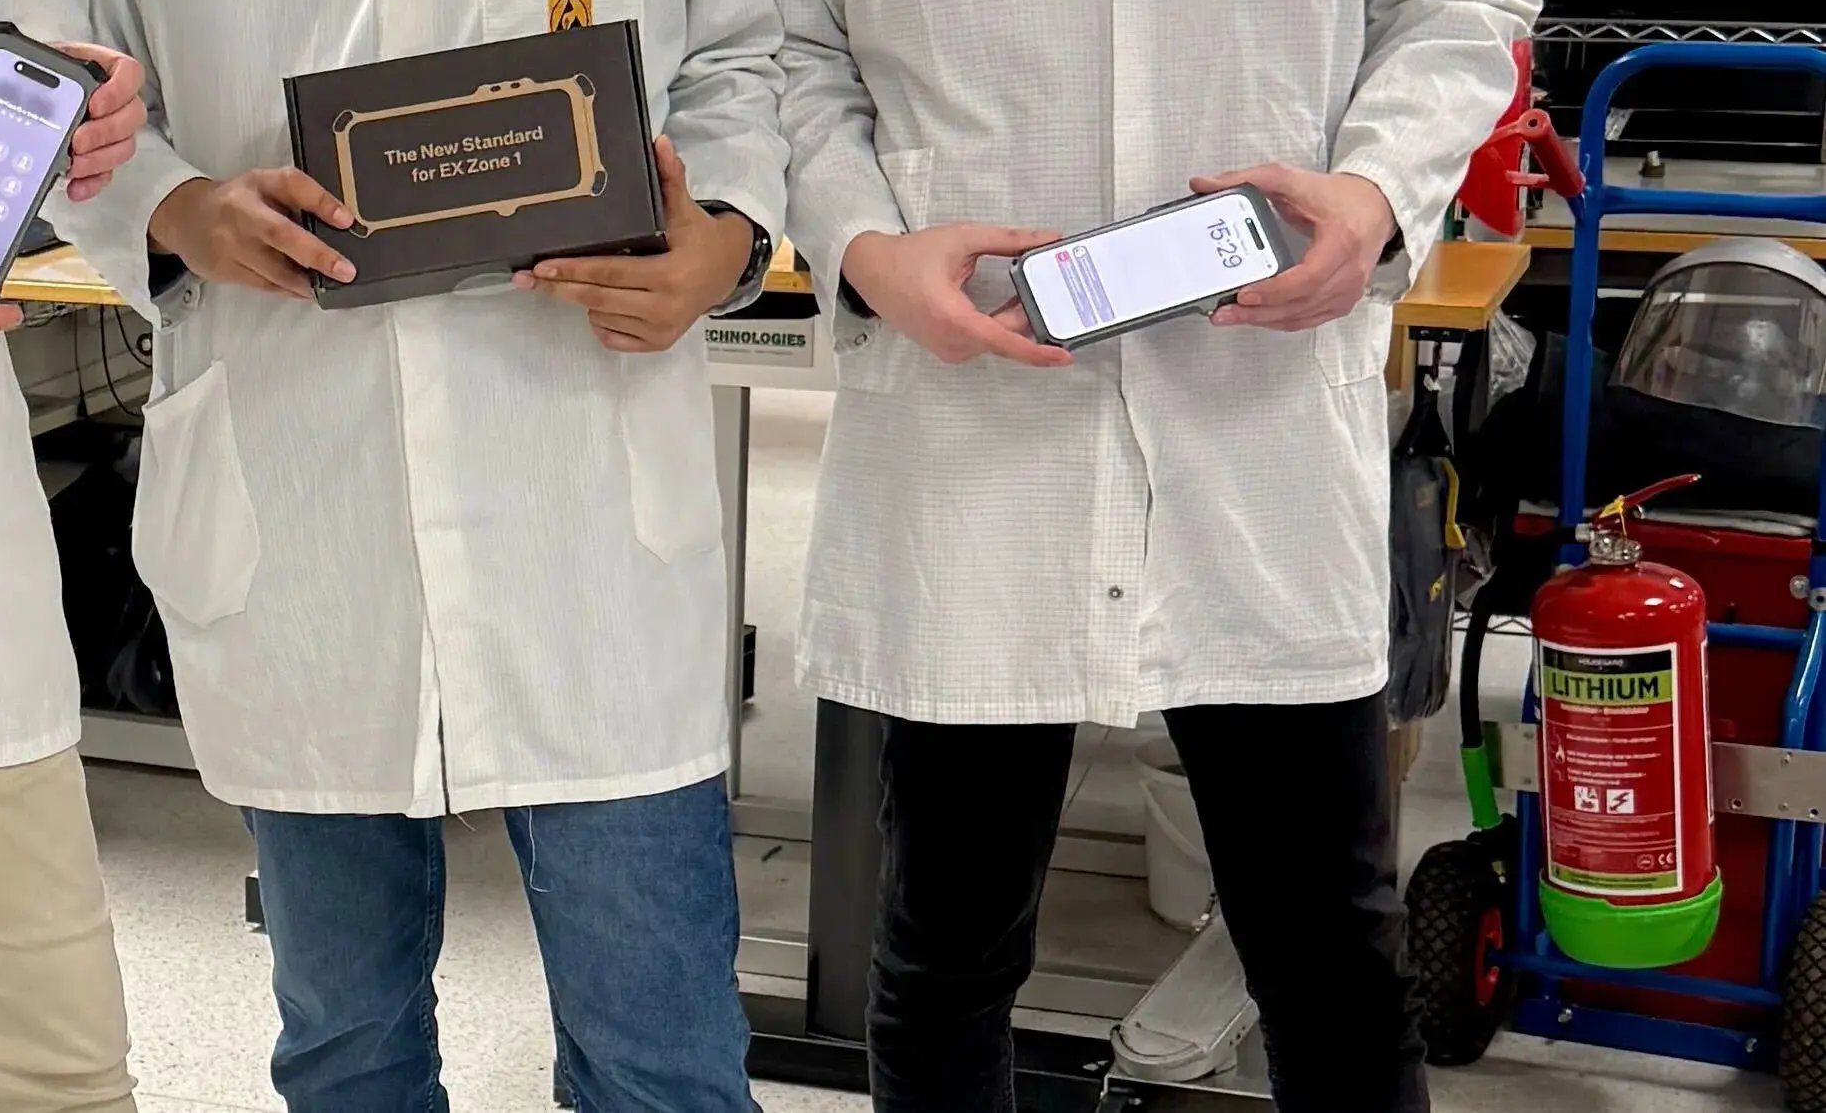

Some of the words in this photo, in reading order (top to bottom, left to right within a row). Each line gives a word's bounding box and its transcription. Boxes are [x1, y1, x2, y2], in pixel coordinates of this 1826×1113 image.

[384, 147, 418, 166] The
[420, 141, 460, 160] New
[462, 126, 544, 152] Standard
[411, 166, 435, 183] for
[439, 161, 465, 179] EX
[466, 154, 511, 175] Zone
[512, 151, 523, 166] 1
[1205, 218, 1243, 270] 15:29
[1551, 672, 1660, 701] LITHIUM
